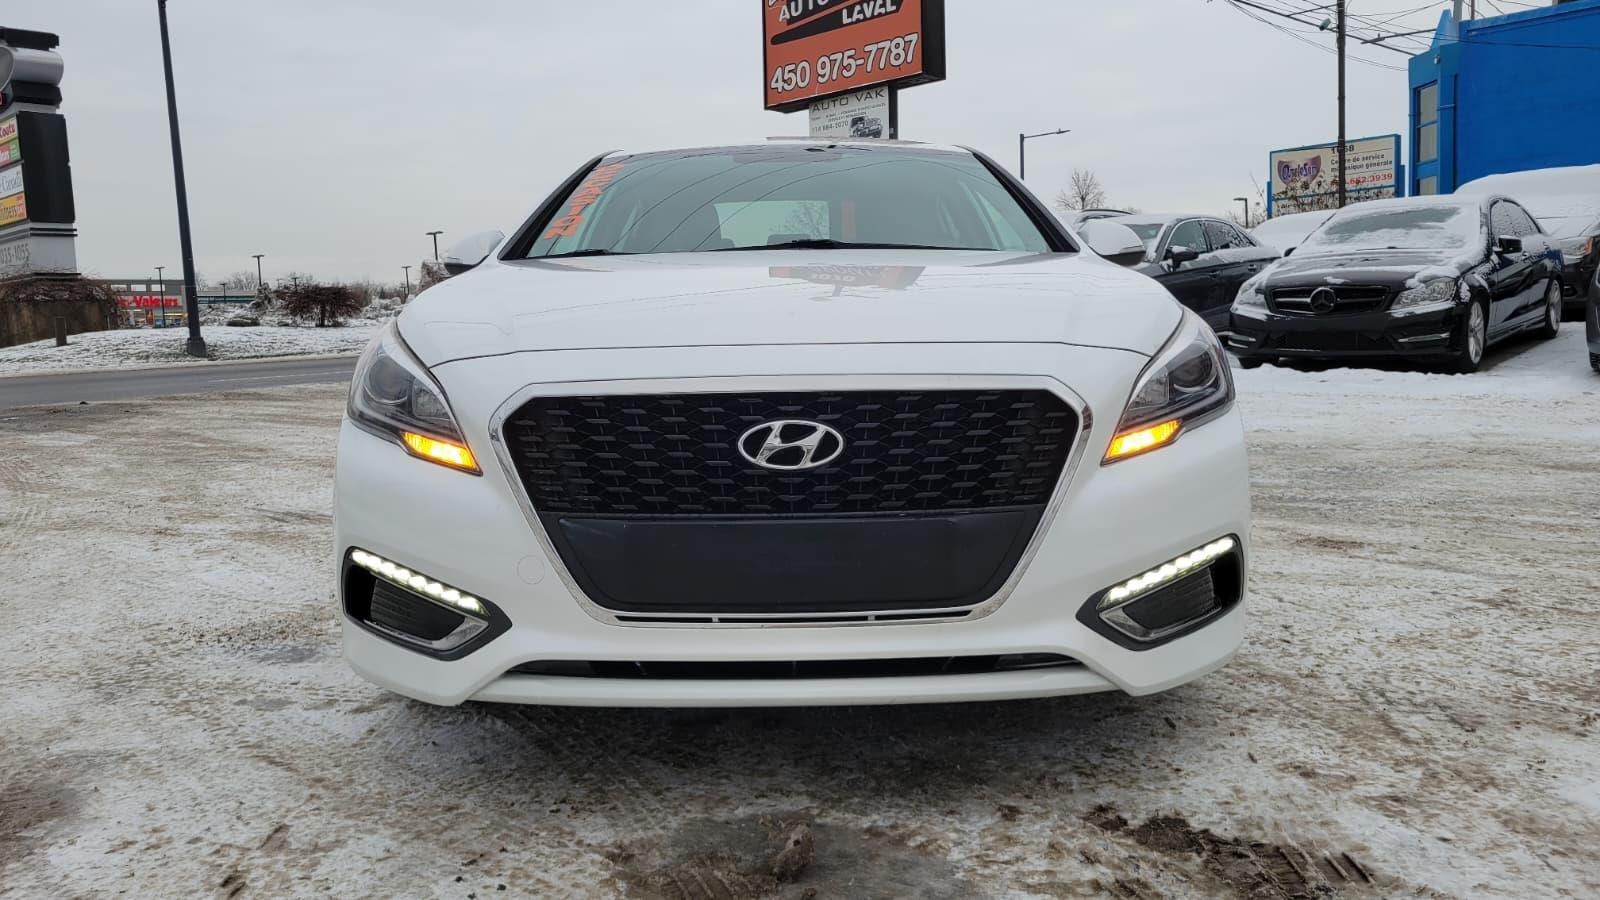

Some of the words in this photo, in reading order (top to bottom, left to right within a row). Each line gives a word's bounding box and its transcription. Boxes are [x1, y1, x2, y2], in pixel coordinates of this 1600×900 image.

[778, 0, 834, 22] AUT
[842, 0, 897, 25] LAVAL
[771, 61, 811, 94] 450
[816, 33, 919, 84] 975-7787
[812, 97, 848, 112] AUTO
[855, 89, 885, 102] VAK
[1362, 153, 1385, 161] service
